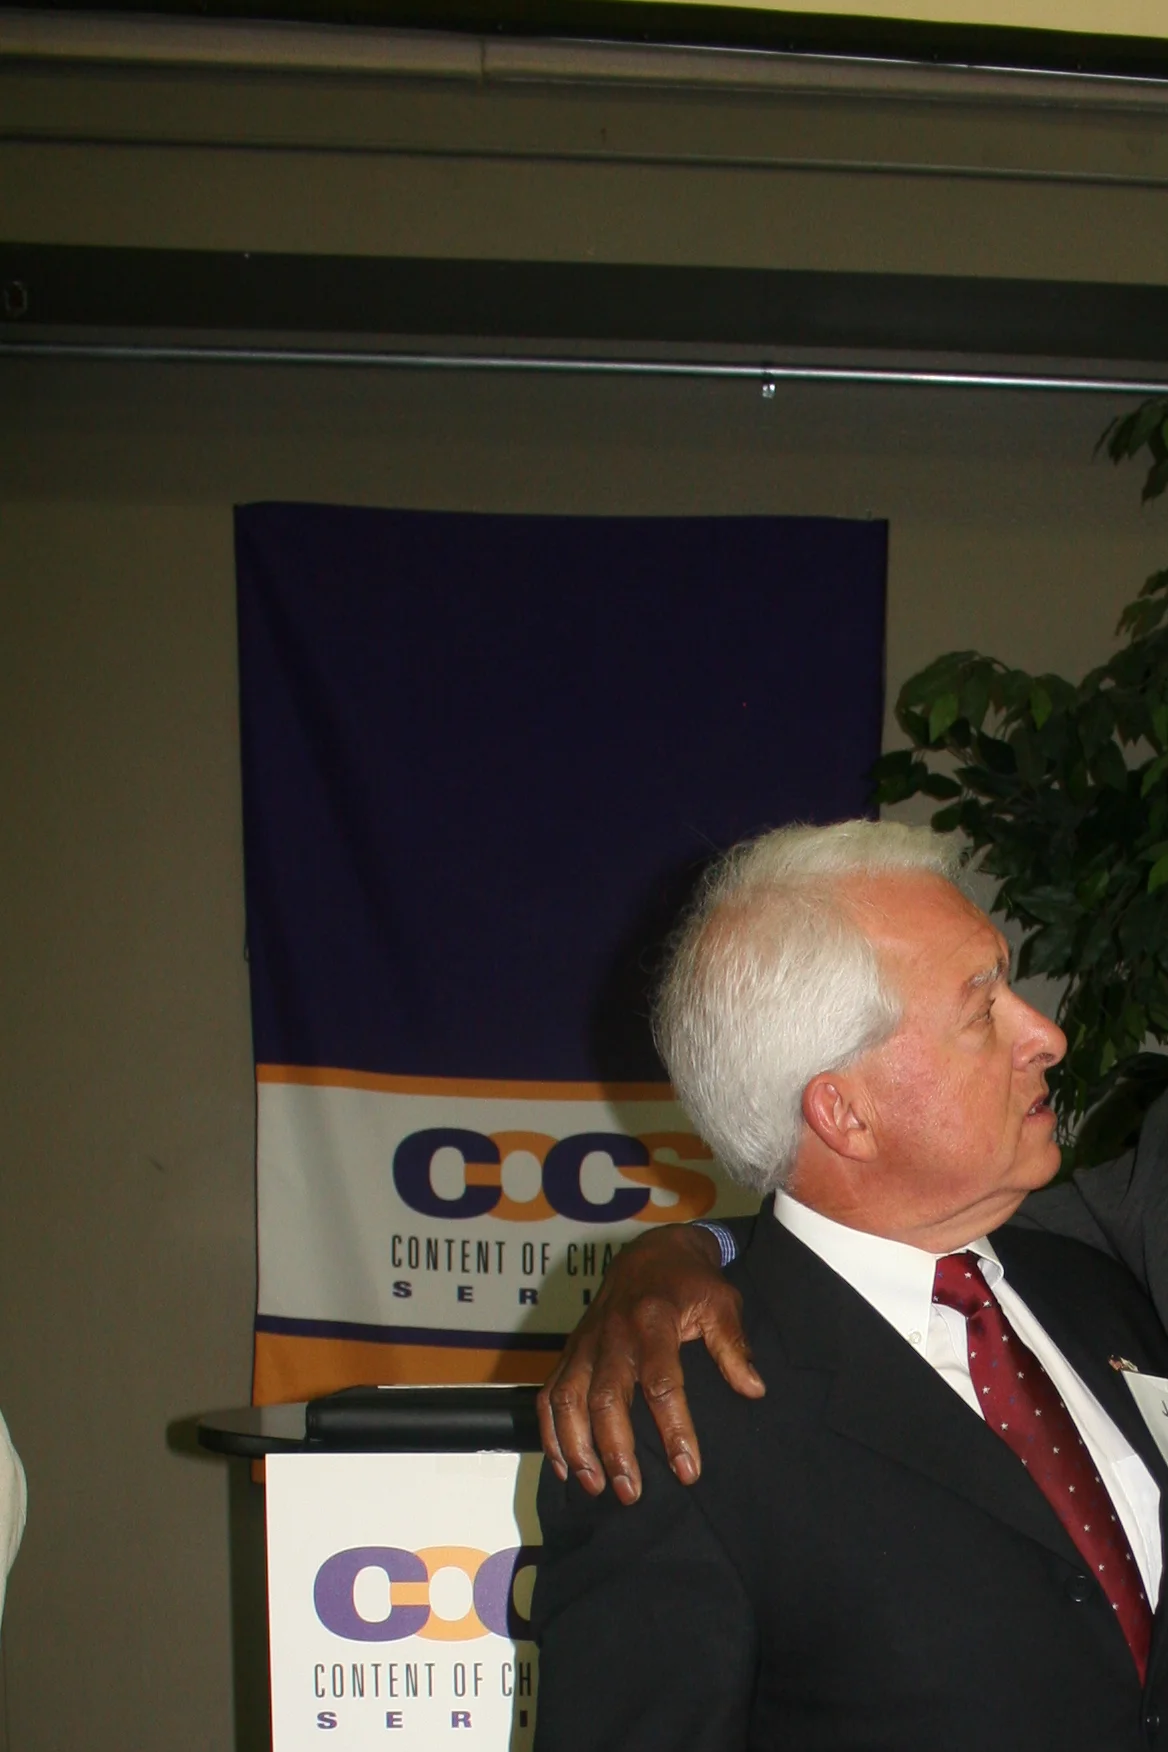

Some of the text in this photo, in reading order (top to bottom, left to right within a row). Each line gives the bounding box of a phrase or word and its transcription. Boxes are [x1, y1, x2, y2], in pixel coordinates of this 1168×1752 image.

[391, 1235, 630, 1276] CONTENT OF CHA
[313, 1662, 436, 1698] CONTENT
[453, 1662, 483, 1697] OF
